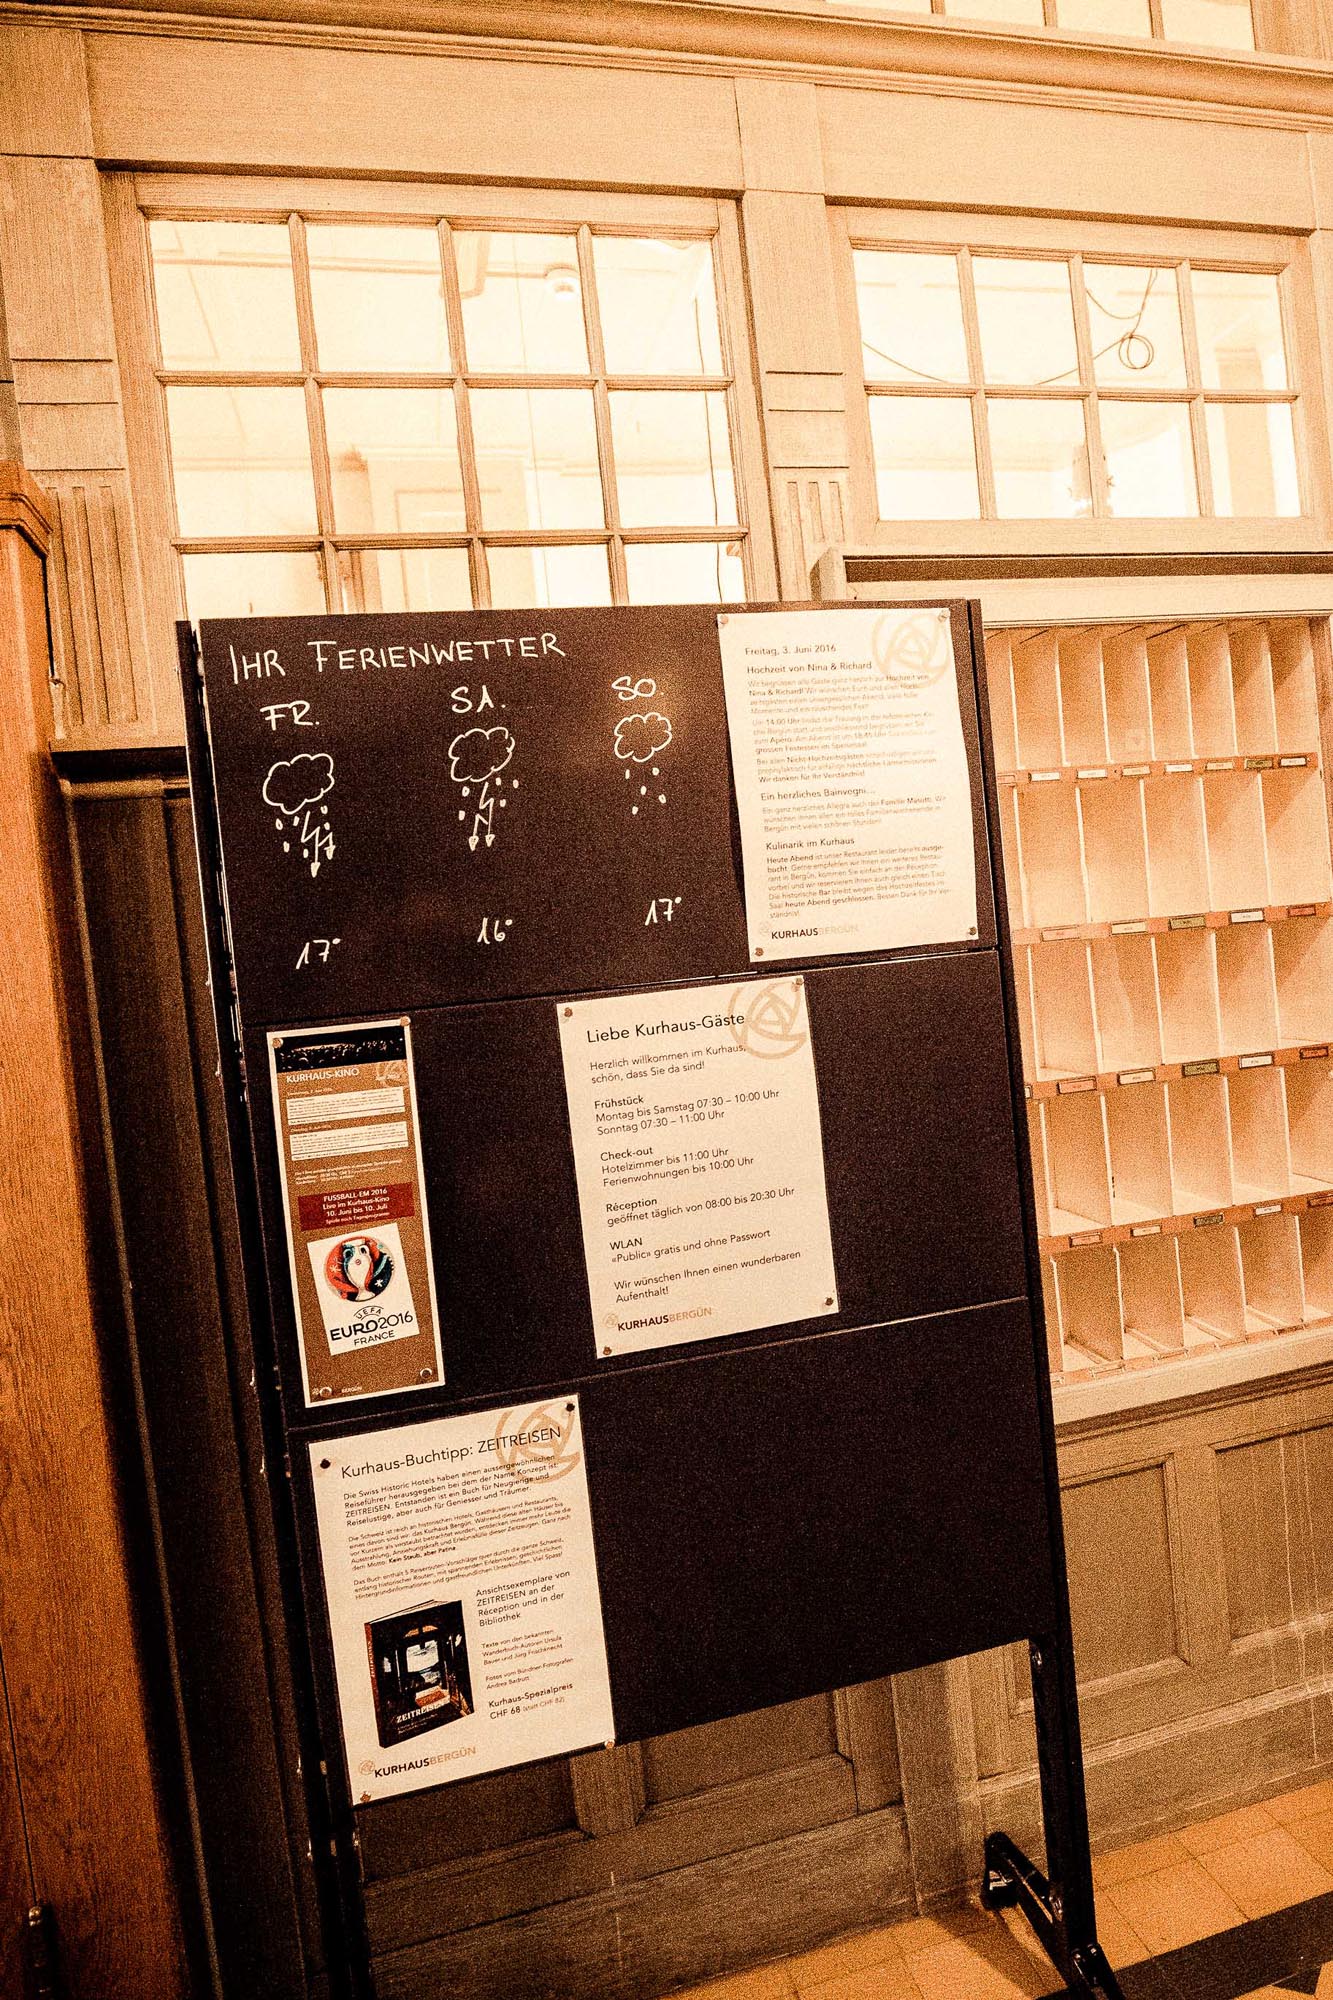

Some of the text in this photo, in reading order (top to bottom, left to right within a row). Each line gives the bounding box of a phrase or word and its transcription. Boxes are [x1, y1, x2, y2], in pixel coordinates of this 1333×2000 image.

[229, 632, 566, 685] IHR FERIENWETTER
[450, 685, 506, 713] SA.
[260, 700, 320, 730] FR.
[587, 1014, 745, 1043] Liebe Kurhaus-Gäste
[590, 1058, 629, 1071] Herzlich
[632, 1052, 689, 1065] willkommen
[706, 1045, 746, 1055] Kurhaus,
[591, 1061, 705, 1084] schön, dass Sie da sind!
[594, 1095, 644, 1109] Frühstück
[596, 1112, 634, 1122] Montag
[636, 1108, 651, 1117] bis
[653, 1103, 695, 1115] Samstag
[697, 1096, 724, 1109] 07:30
[734, 1091, 761, 1103] 10:00
[762, 1090, 779, 1100] Uhr
[597, 1124, 638, 1136] Sonntag
[640, 1117, 668, 1130] 07:30
[680, 1112, 706, 1124] 11:00
[708, 1110, 725, 1120] Uhr
[600, 1147, 653, 1162] Check-out
[602, 1148, 729, 1174] Hotelzimmer bis 11:00 Uhr
[603, 1157, 754, 1187] Ferienwohnungen bis 10:00 Uhr
[371, 1188, 388, 1196] 2016
[606, 1198, 658, 1212] Réception
[338, 1208, 352, 1216] Juni
[607, 1188, 795, 1228] geöffnet täglich von 08:00 bis 20:30 Uhr
[609, 1238, 643, 1250] WLAN
[654, 1245, 681, 1259] gratis
[683, 1240, 701, 1252] und
[704, 1238, 728, 1248] ohne
[730, 1230, 771, 1243] Passwort
[614, 1252, 801, 1290] Wir wünschen Ihnen einen wunderbaren
[616, 1286, 669, 1303] Aufenthalt!
[356, 1307, 382, 1321] UEFA
[353, 1330, 395, 1346] FRANCE
[477, 1426, 561, 1454] ZEITREISEN
[344, 1496, 387, 1509] Reiseführer
[388, 1485, 446, 1500] herausgegeben
[462, 1479, 478, 1487] dem
[494, 1469, 516, 1480] Name
[517, 1465, 546, 1477] Konzept
[358, 1489, 379, 1498] Swiss
[381, 1482, 410, 1493] Historic
[411, 1477, 435, 1486] Hotels
[462, 1470, 481, 1478] einen
[483, 1455, 556, 1473] aussergewöhnlichen
[395, 1496, 436, 1509] Entstanden
[462, 1487, 480, 1496] Buch
[493, 1476, 535, 1489] Neugierige
[534, 1472, 551, 1483] und
[346, 1514, 394, 1527] Reiselustige,
[396, 1509, 413, 1517] aber
[415, 1504, 432, 1514] auch
[446, 1496, 482, 1507] Geniesser
[484, 1491, 498, 1500] und
[476, 1571, 570, 1597] Ansichtsexemplare von
[477, 1584, 555, 1607] ZEITREISEN an der
[478, 1603, 520, 1617] Réception
[522, 1597, 538, 1607] und
[550, 1593, 564, 1601] der
[479, 1612, 521, 1627] Bibliothek
[488, 1683, 573, 1708] Kurhaus-Spezialpreis
[489, 1708, 508, 1720] CHF
[510, 1706, 521, 1715] 68
